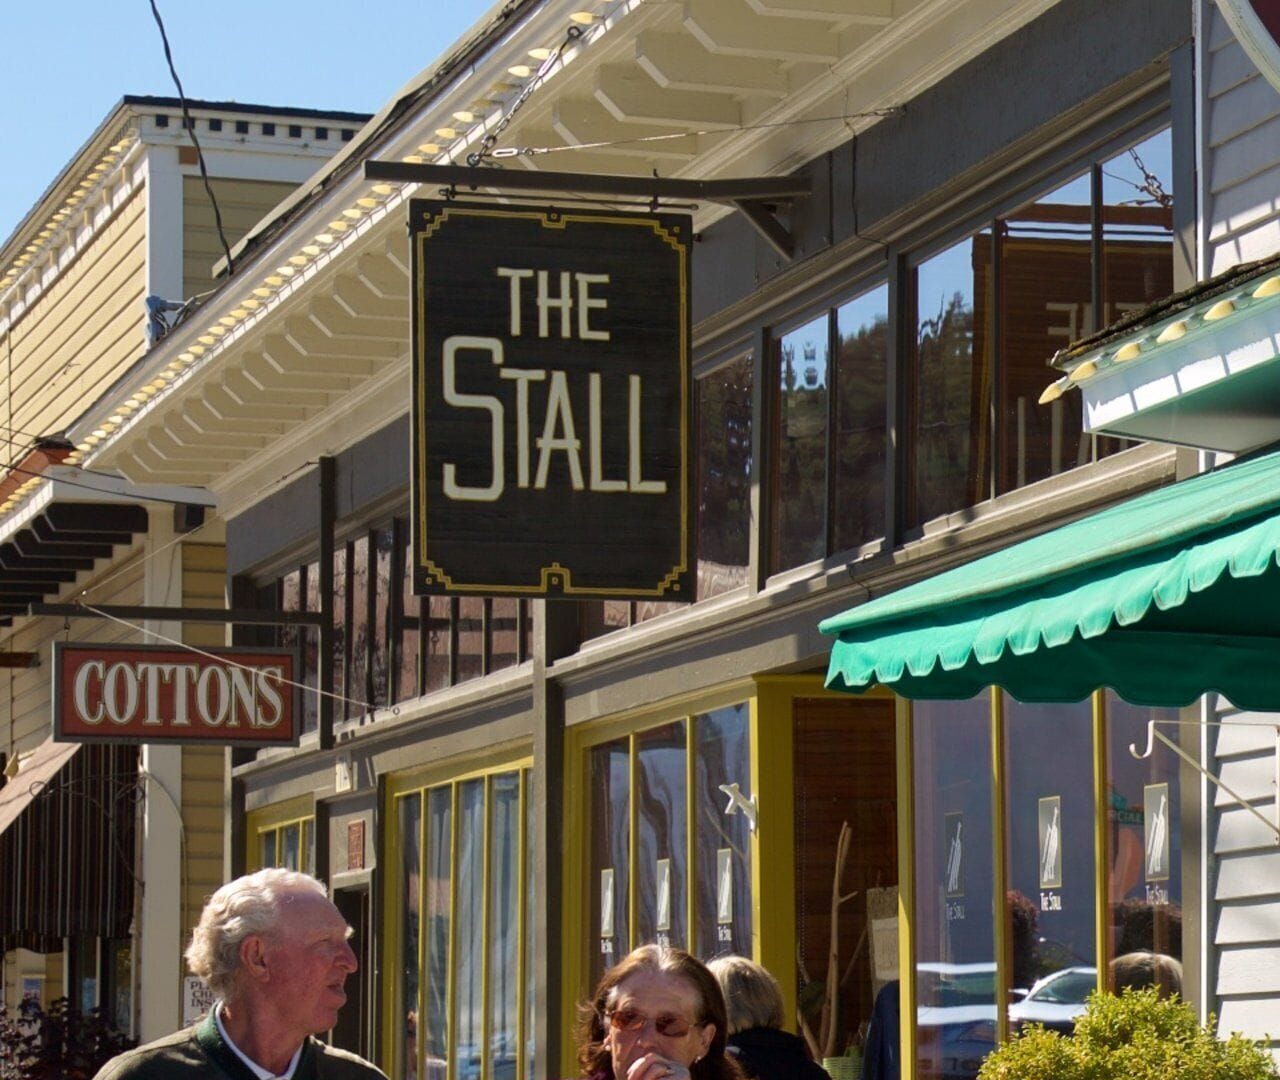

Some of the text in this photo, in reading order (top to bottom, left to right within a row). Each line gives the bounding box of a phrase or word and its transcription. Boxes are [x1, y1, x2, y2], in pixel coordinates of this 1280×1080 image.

[497, 267, 610, 341] THE
[442, 336, 667, 501] STALL
[73, 659, 284, 729] COTTONS
